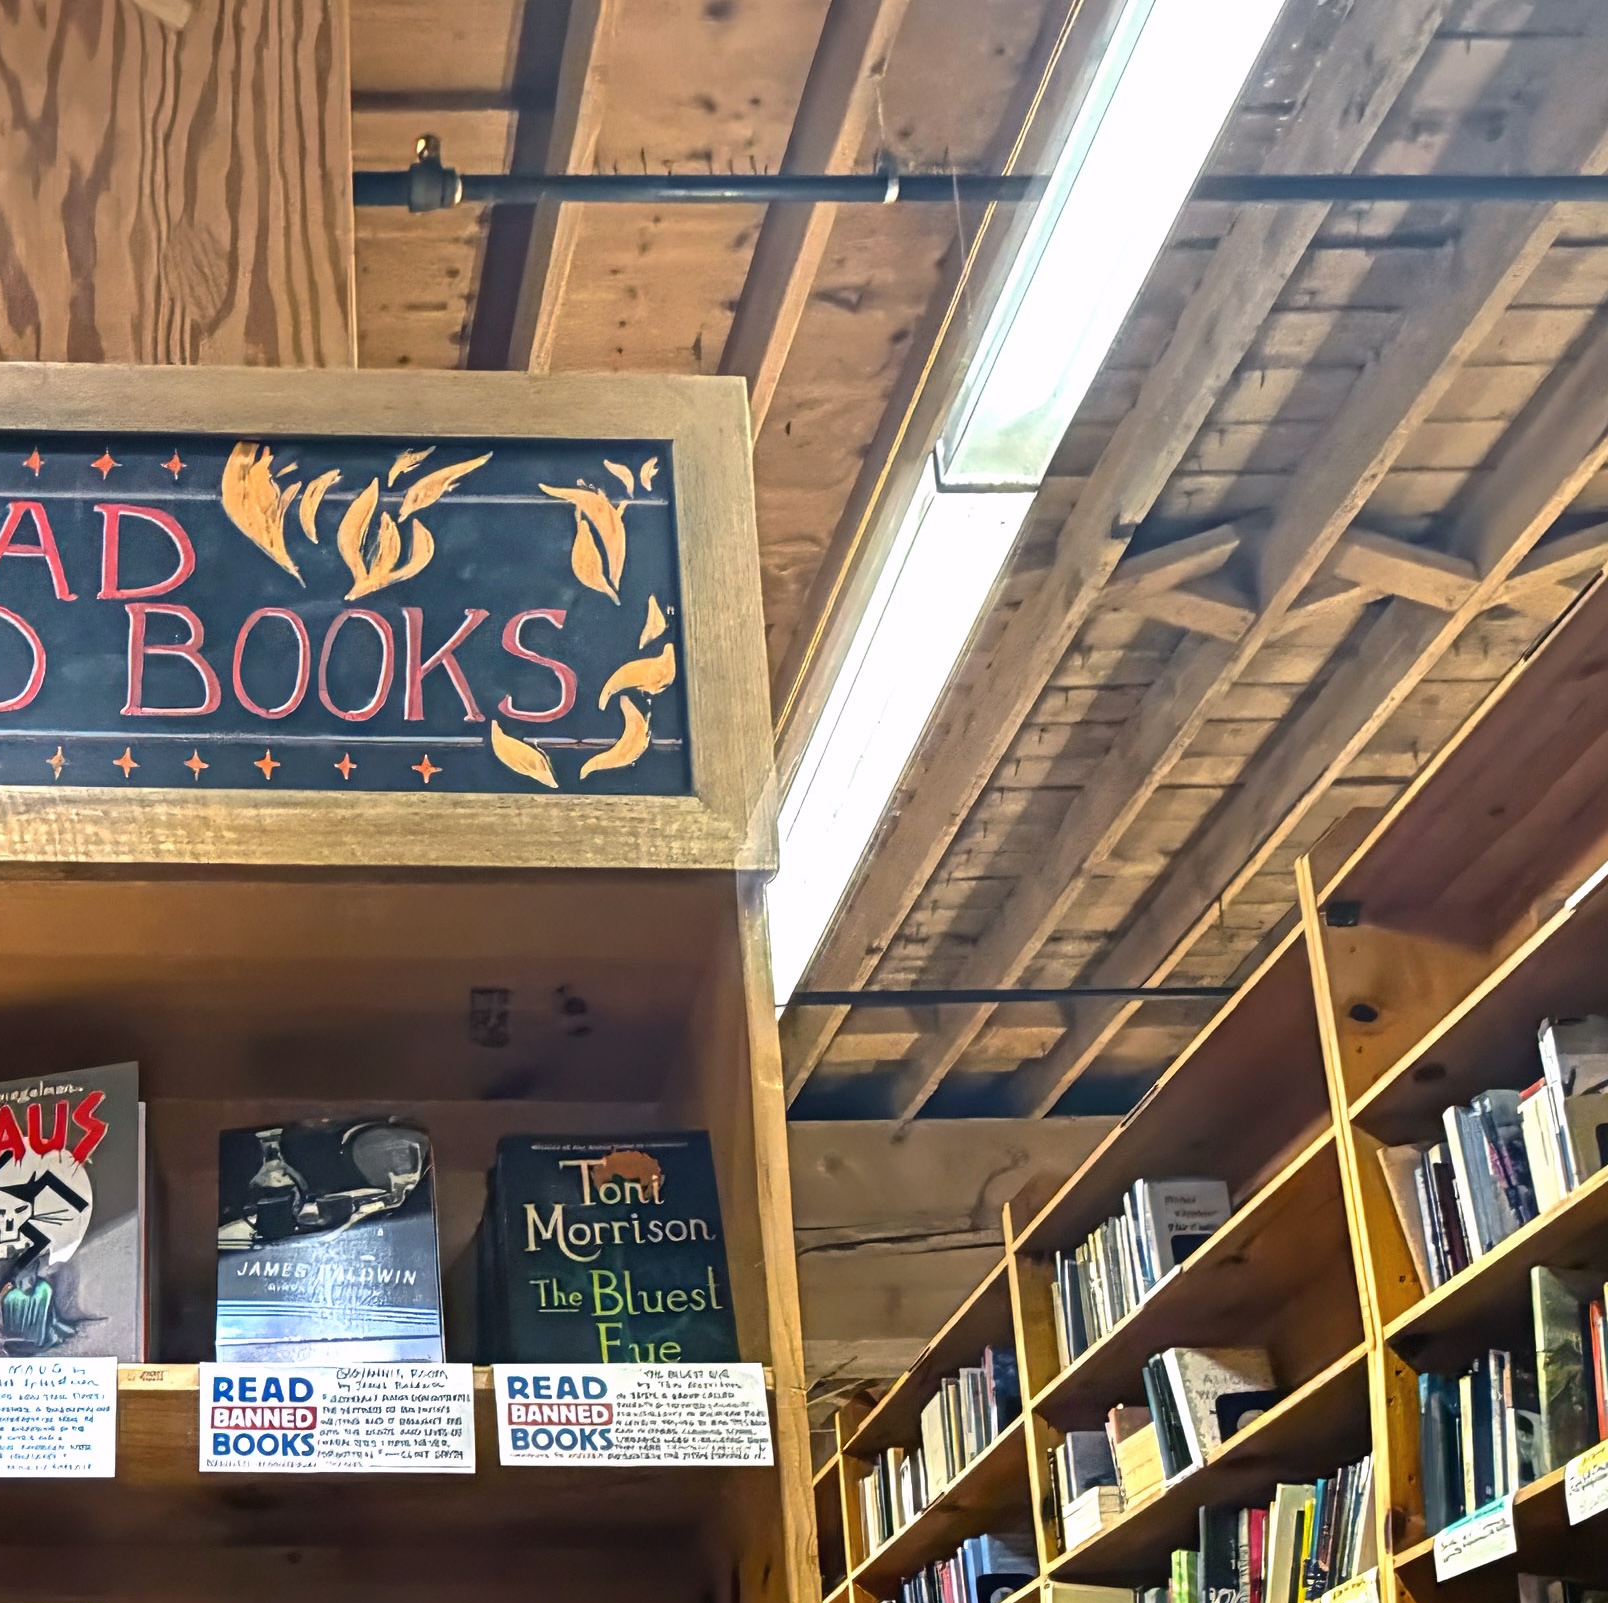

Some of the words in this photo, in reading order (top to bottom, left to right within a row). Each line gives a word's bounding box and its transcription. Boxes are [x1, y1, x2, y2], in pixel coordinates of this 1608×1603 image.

[125, 604, 577, 722] BOOKS
[559, 1159, 664, 1206] Toni
[523, 1204, 715, 1262] Morrison
[237, 1261, 309, 1278] JAMES
[529, 1278, 583, 1307] The
[590, 1266, 722, 1317] Bluest
[212, 1376, 314, 1402] READ
[508, 1376, 607, 1400] READ
[212, 1408, 313, 1429] BANNED
[511, 1405, 609, 1424] BANNED
[212, 1433, 316, 1456] BOOKS
[510, 1428, 612, 1451] BOOKS
